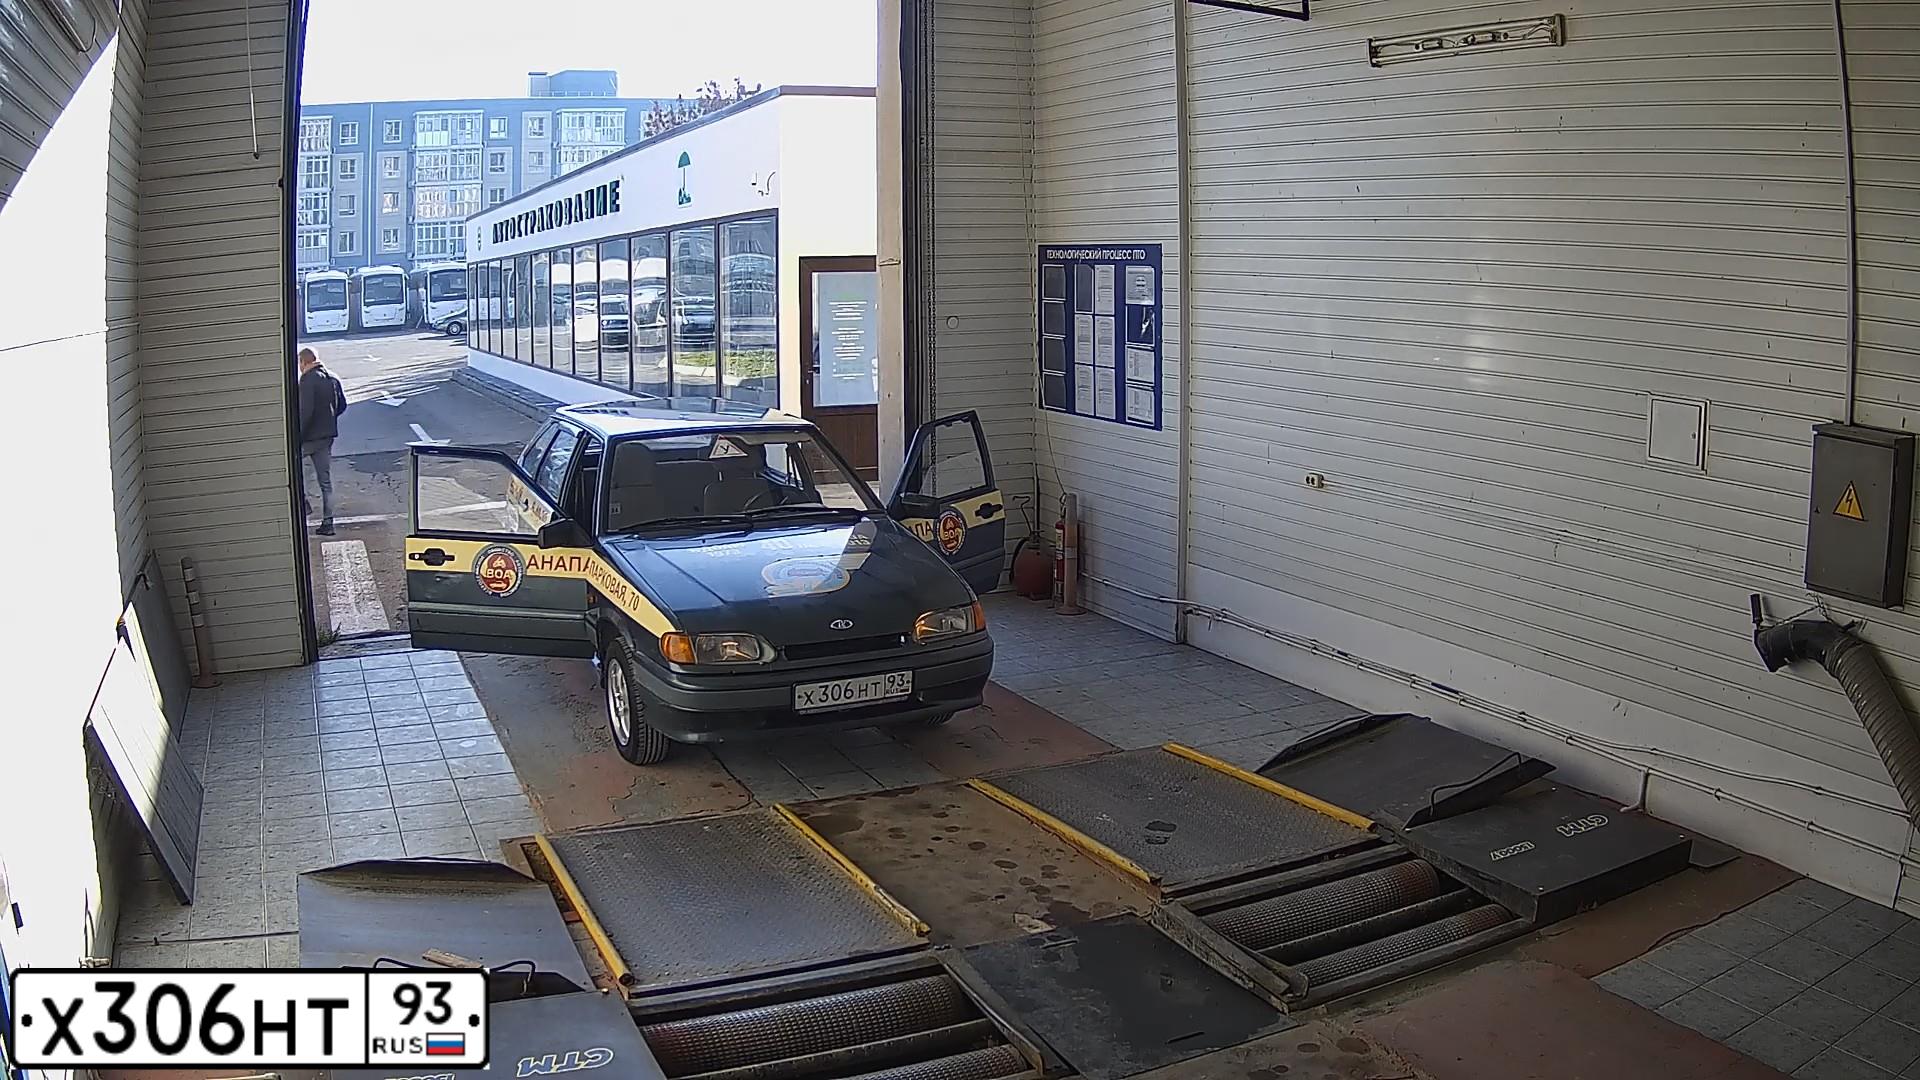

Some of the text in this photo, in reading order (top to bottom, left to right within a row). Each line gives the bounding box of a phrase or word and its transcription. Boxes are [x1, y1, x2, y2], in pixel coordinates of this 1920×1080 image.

[1102, 249, 1132, 260] ПРОЦЕСС
[628, 592, 641, 612] 70
[886, 673, 906, 690] 93
